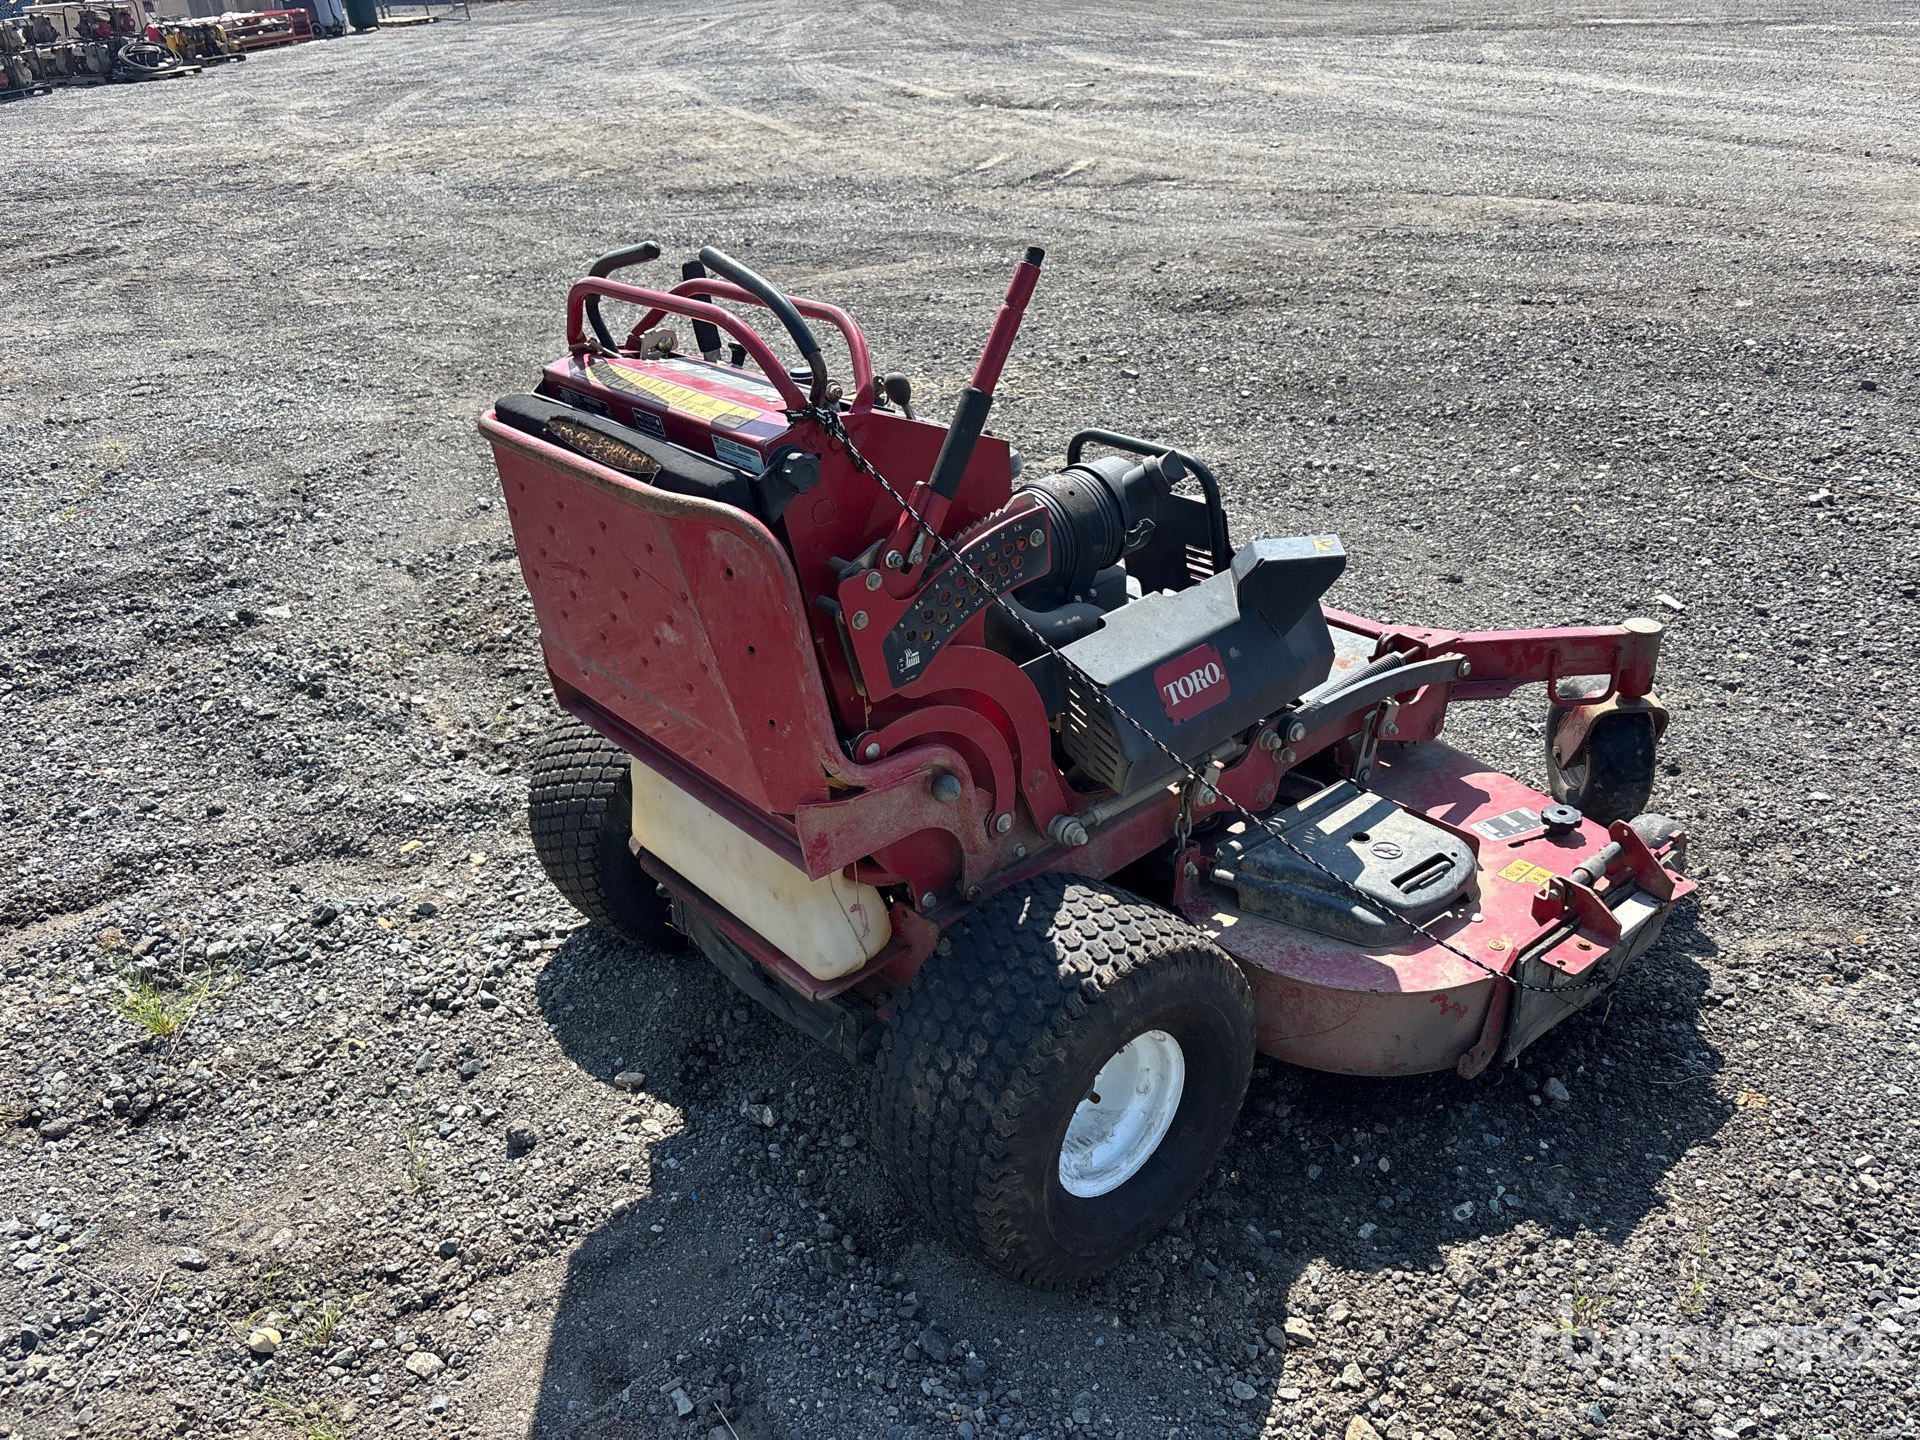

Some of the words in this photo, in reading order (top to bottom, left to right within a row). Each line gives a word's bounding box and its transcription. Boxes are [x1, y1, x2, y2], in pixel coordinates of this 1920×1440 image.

[1014, 524, 1022, 533] 1.5
[981, 541, 990, 552] 2.5
[948, 566, 958, 576] 3.5
[914, 600, 924, 610] 4.5
[1163, 662, 1221, 706] TORO
